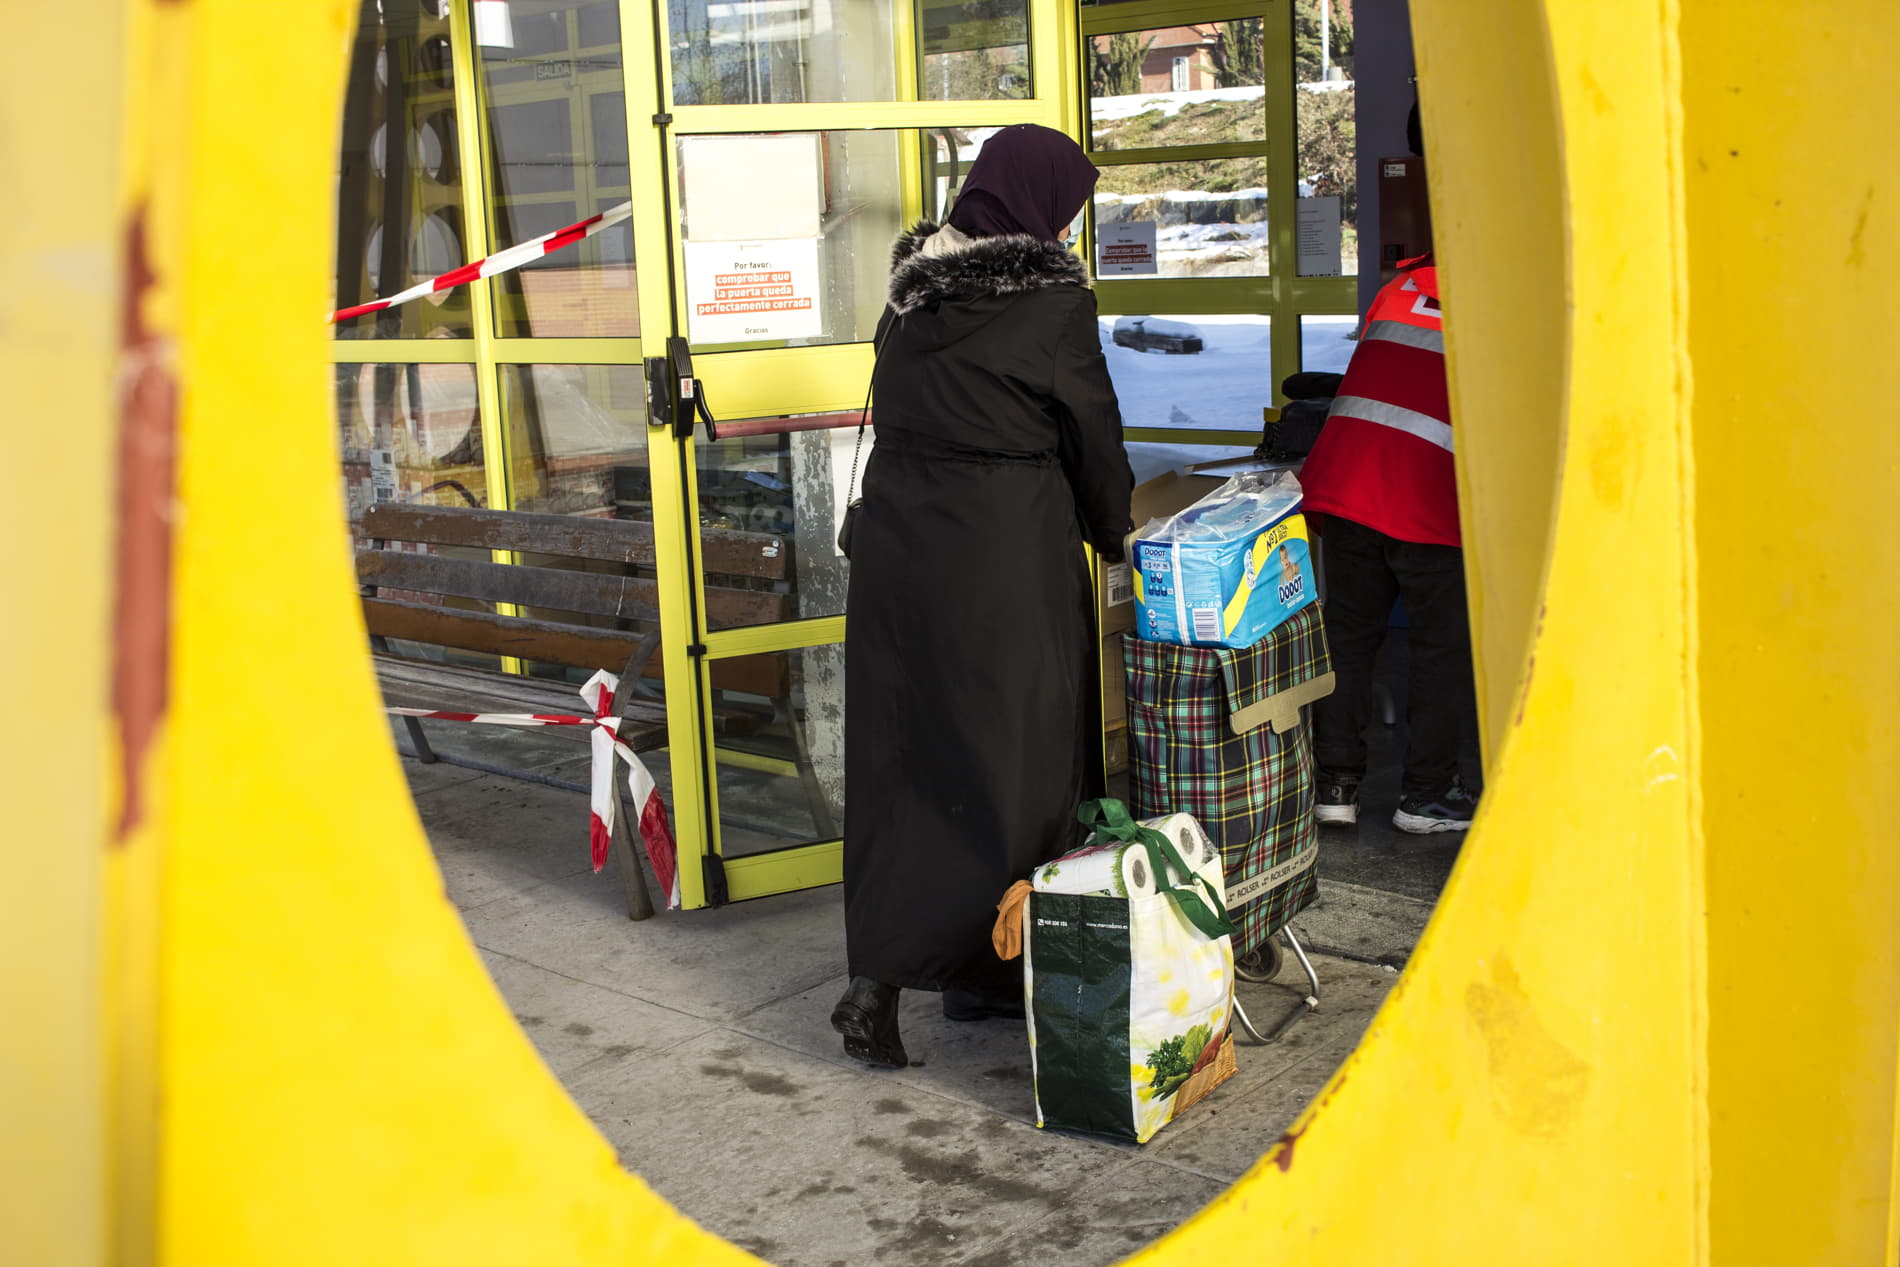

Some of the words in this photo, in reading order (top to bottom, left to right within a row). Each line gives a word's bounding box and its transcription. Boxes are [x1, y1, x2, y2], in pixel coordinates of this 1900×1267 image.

[734, 262, 747, 270] Por
[716, 272, 770, 285] comprobar
[771, 273, 790, 284] que
[716, 289, 726, 299] la
[728, 287, 761, 300] puerta
[762, 285, 792, 297] queda
[698, 301, 771, 315] perfectamente
[773, 297, 810, 310] cerrada
[1279, 576, 1303, 603] DODOT
[1237, 881, 1260, 898] ROLSER
[1270, 865, 1291, 883] ROLSER
